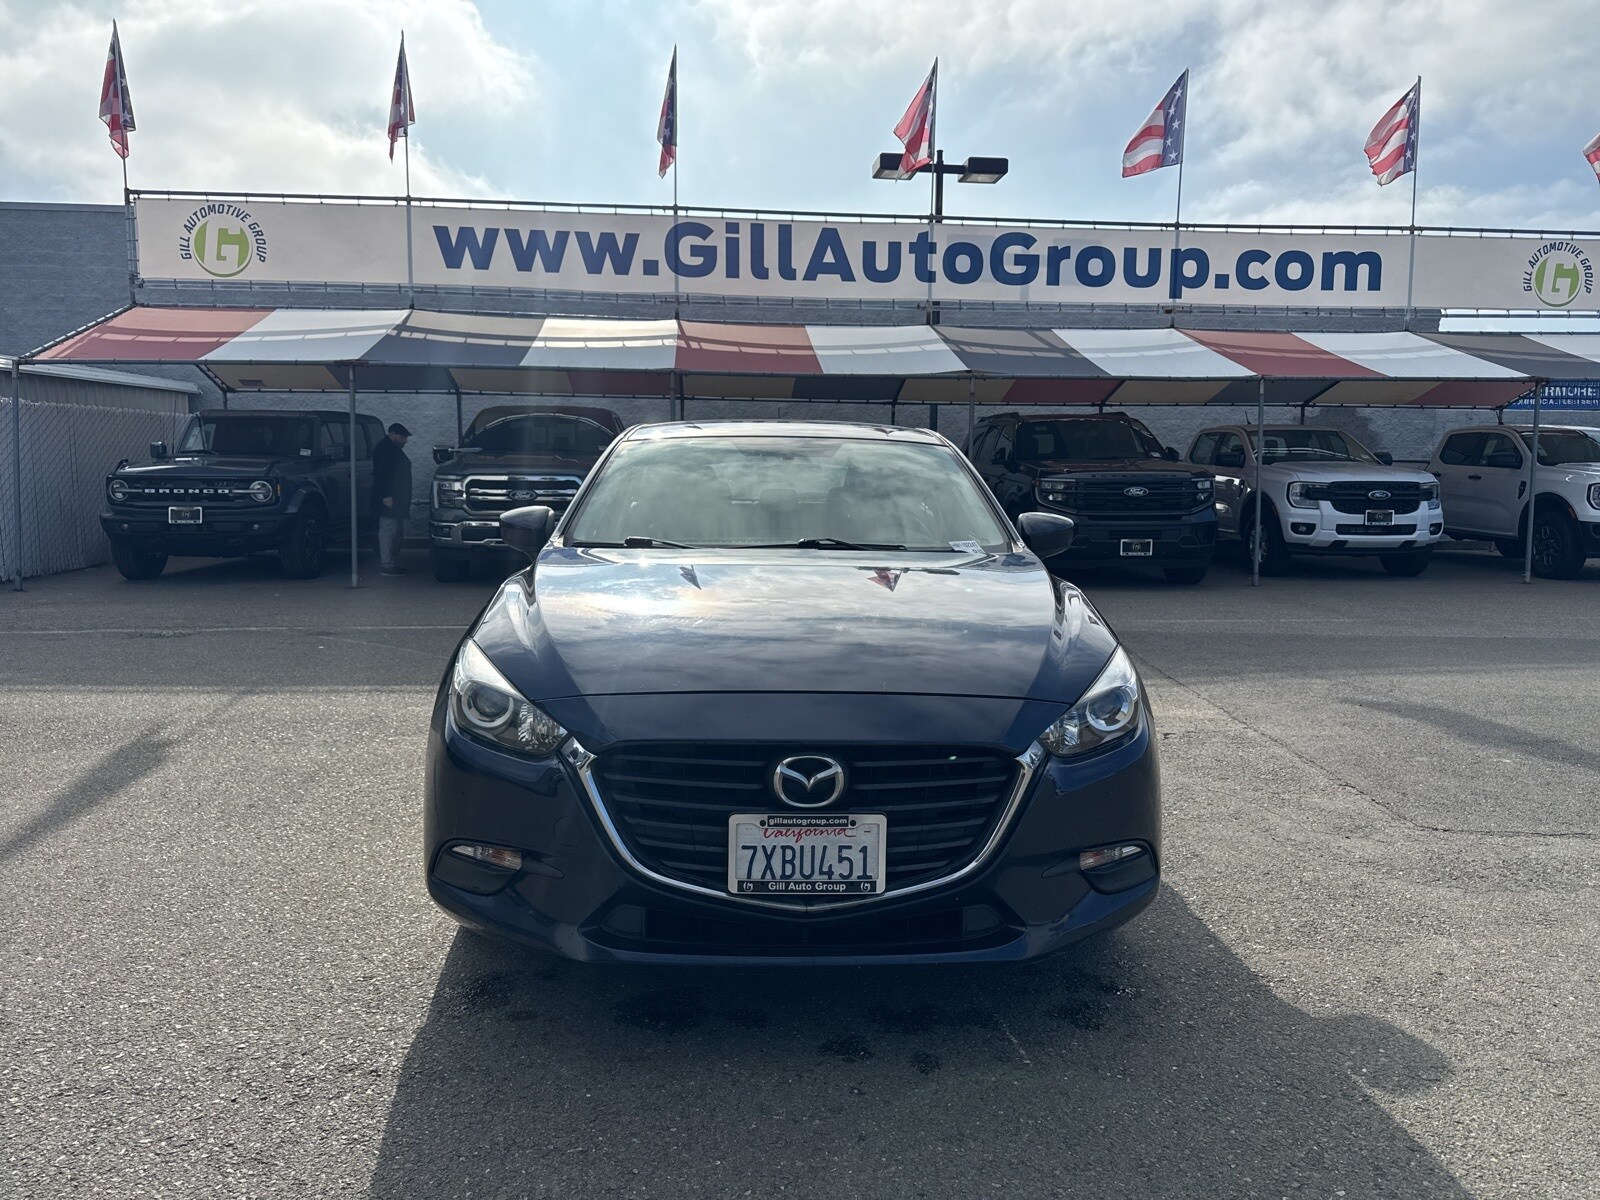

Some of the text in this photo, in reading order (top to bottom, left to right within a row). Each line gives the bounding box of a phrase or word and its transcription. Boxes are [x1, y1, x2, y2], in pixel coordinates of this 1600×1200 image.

[179, 203, 267, 263] GILL AUTOMOTIVE GROUP
[433, 221, 1382, 299] www.GillAutoGroup.com
[1523, 241, 1594, 294] GILL AUTOMOTIVE GROUP
[768, 816, 848, 826] gillautogroup.com
[741, 845, 873, 880] 7XBU451
[768, 882, 785, 891] Gill
[788, 882, 812, 891] Auto
[815, 882, 846, 892] Group
